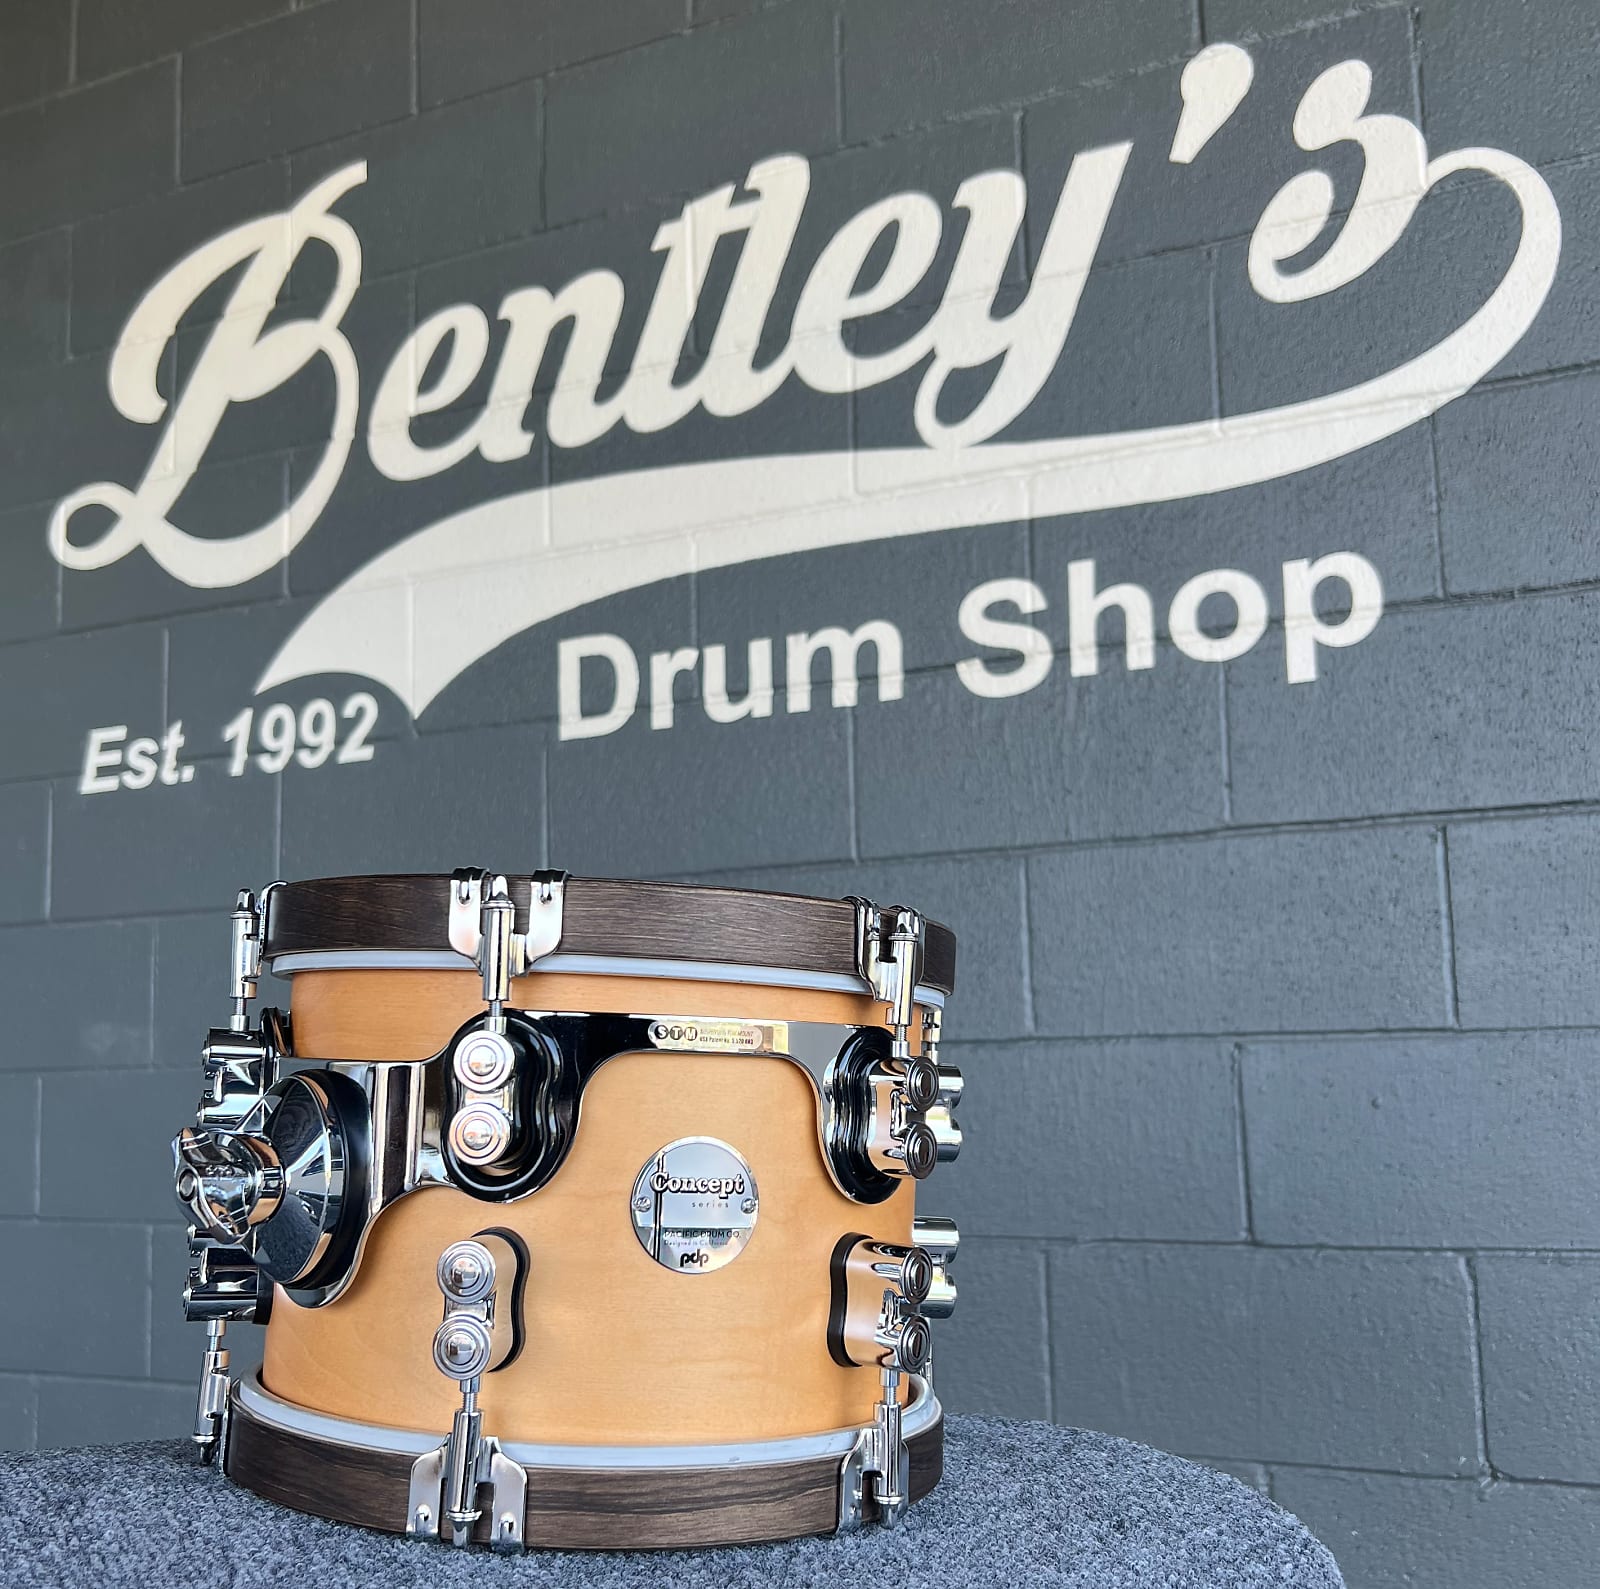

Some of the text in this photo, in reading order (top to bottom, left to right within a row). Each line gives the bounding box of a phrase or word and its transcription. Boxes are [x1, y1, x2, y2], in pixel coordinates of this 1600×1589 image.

[49, 43, 1562, 588] Bentley's
[558, 551, 1385, 741] Drum Shop
[80, 692, 379, 794] Est. 1992
[655, 1025, 698, 1041] STM
[650, 1172, 745, 1199] Concept
[692, 1200, 729, 1208] series
[664, 1230, 742, 1238] PACIFIC DRUM CO.
[680, 1249, 709, 1267] pdp
